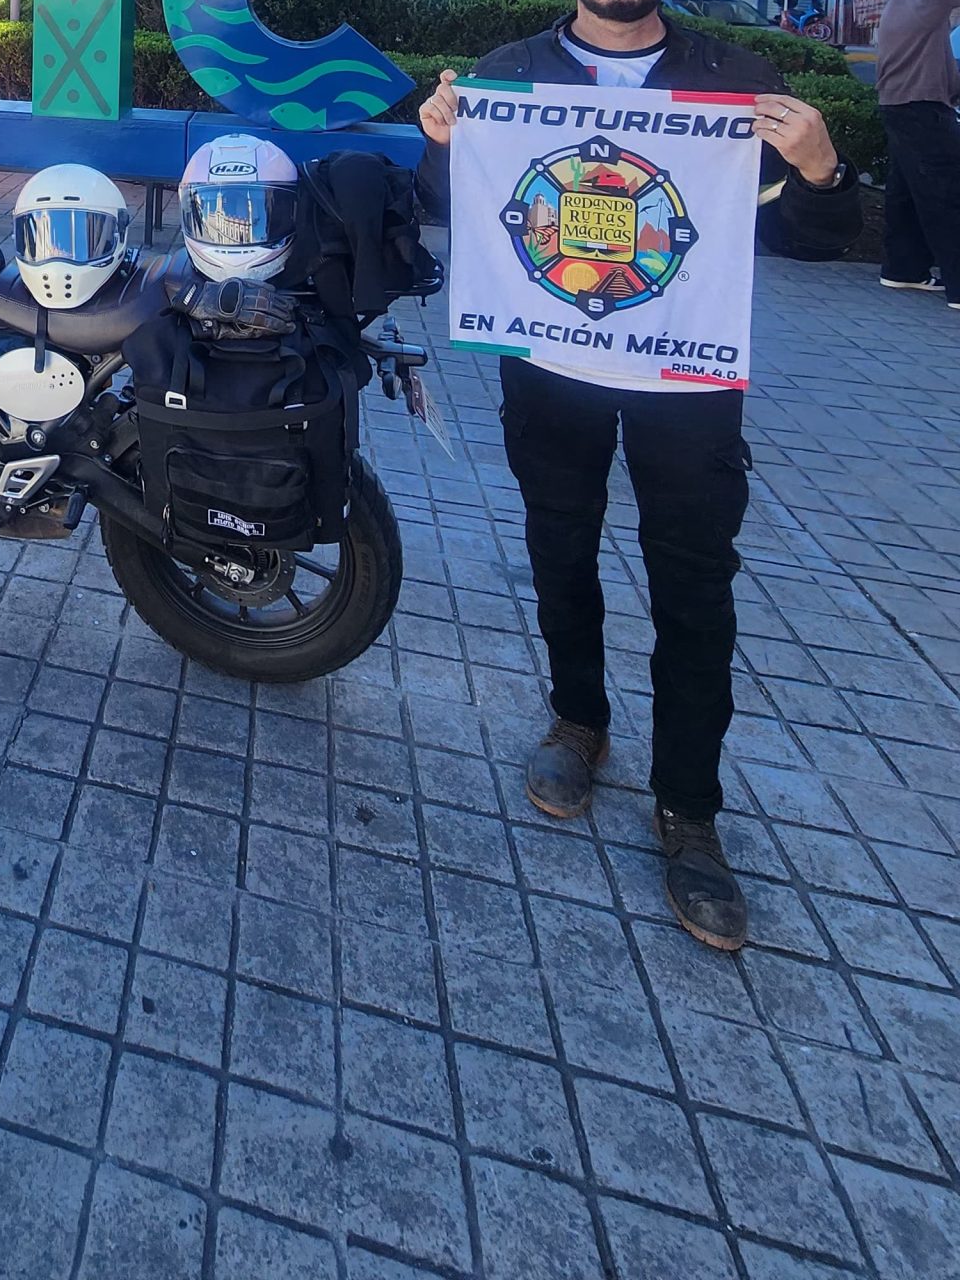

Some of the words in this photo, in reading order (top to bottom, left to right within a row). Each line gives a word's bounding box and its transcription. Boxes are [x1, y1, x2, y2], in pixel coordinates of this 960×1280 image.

[457, 95, 757, 140] MOTOTURISMO
[590, 143, 609, 158] N
[213, 164, 251, 174] HJC
[505, 210, 524, 225] O
[675, 228, 691, 242] E
[588, 297, 604, 312] S
[459, 312, 495, 332] EN
[505, 316, 614, 351] ACCIÓN
[626, 331, 739, 364] MÉXICO
[671, 362, 705, 376] RRM
[711, 368, 738, 381] 4.0
